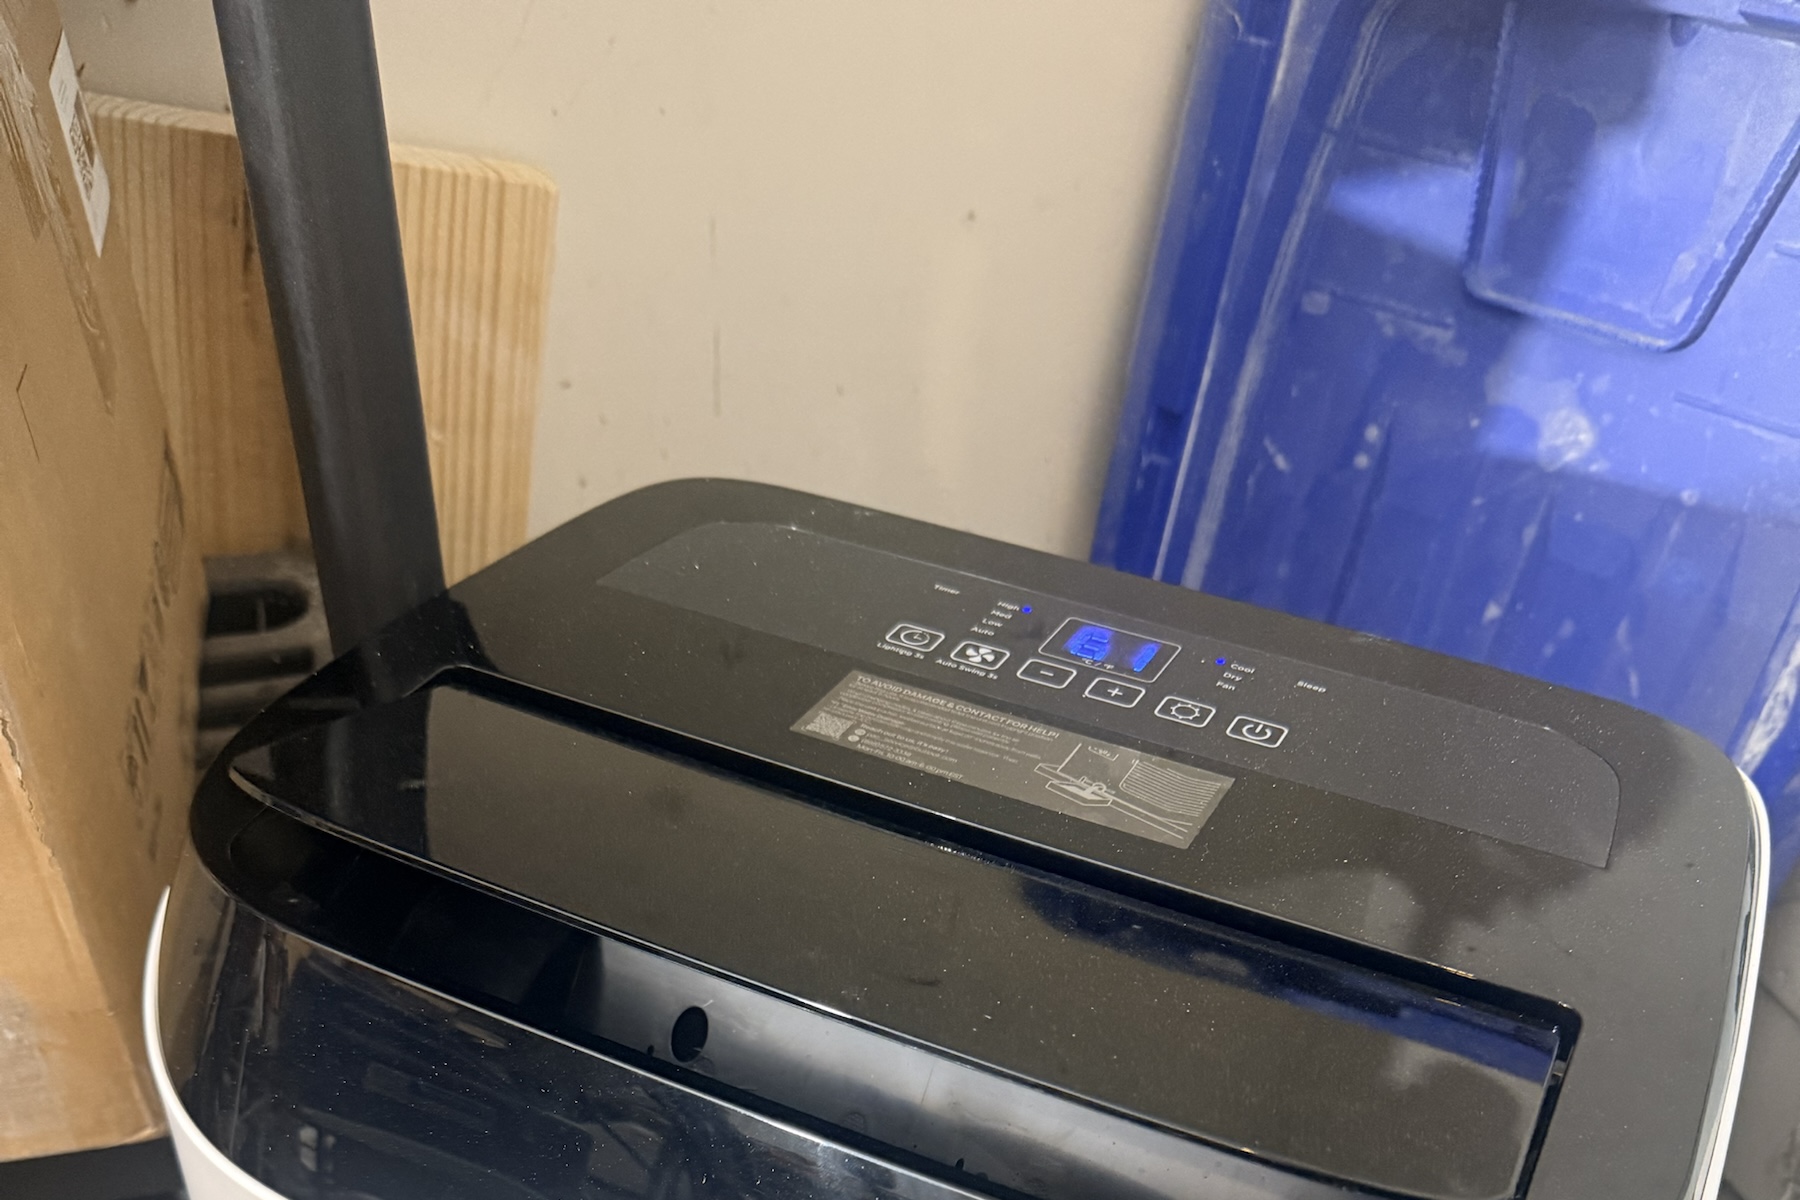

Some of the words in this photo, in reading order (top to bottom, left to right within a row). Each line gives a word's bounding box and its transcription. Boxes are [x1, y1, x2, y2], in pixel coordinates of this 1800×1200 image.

[933, 584, 960, 595] Timer
[997, 601, 1020, 612] High
[990, 610, 1013, 620] Med
[981, 618, 1004, 628] Low
[970, 626, 995, 637] Auto
[935, 658, 957, 669] Auto
[1230, 663, 1256, 675] Cool
[1222, 671, 1243, 682] Dry
[1215, 680, 1236, 692] Fan
[1296, 680, 1327, 694] Sleep
[870, 680, 904, 693] AVOID
[902, 689, 947, 704] DAMAGE
[956, 706, 1008, 723] CONTACT
[1006, 719, 1028, 729] FOR
